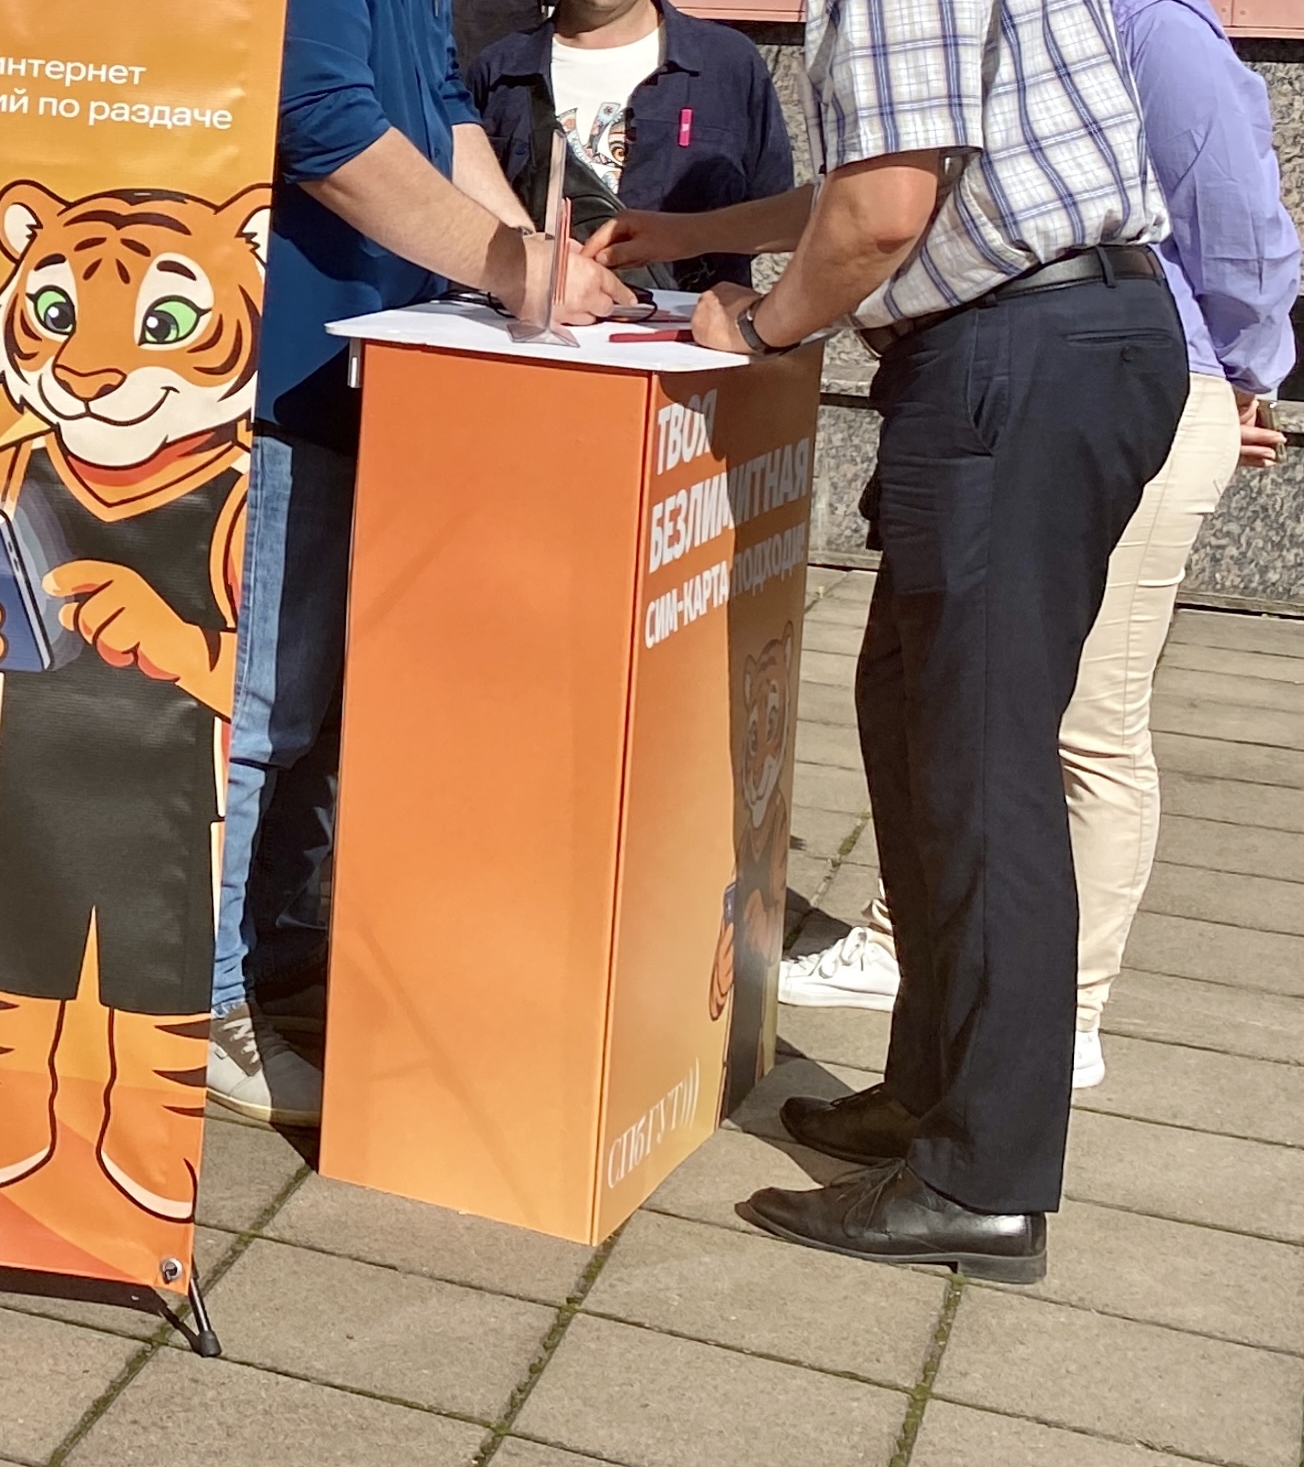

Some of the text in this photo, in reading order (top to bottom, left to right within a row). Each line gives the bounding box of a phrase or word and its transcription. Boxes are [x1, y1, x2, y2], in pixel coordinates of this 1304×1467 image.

[38, 98, 80, 119] по
[88, 100, 233, 130] раздаче
[657, 388, 718, 475] ТВОЯ
[649, 437, 810, 574] БЕЗЛИМИТНАЯ
[645, 560, 730, 649] СИМ-КАРТА
